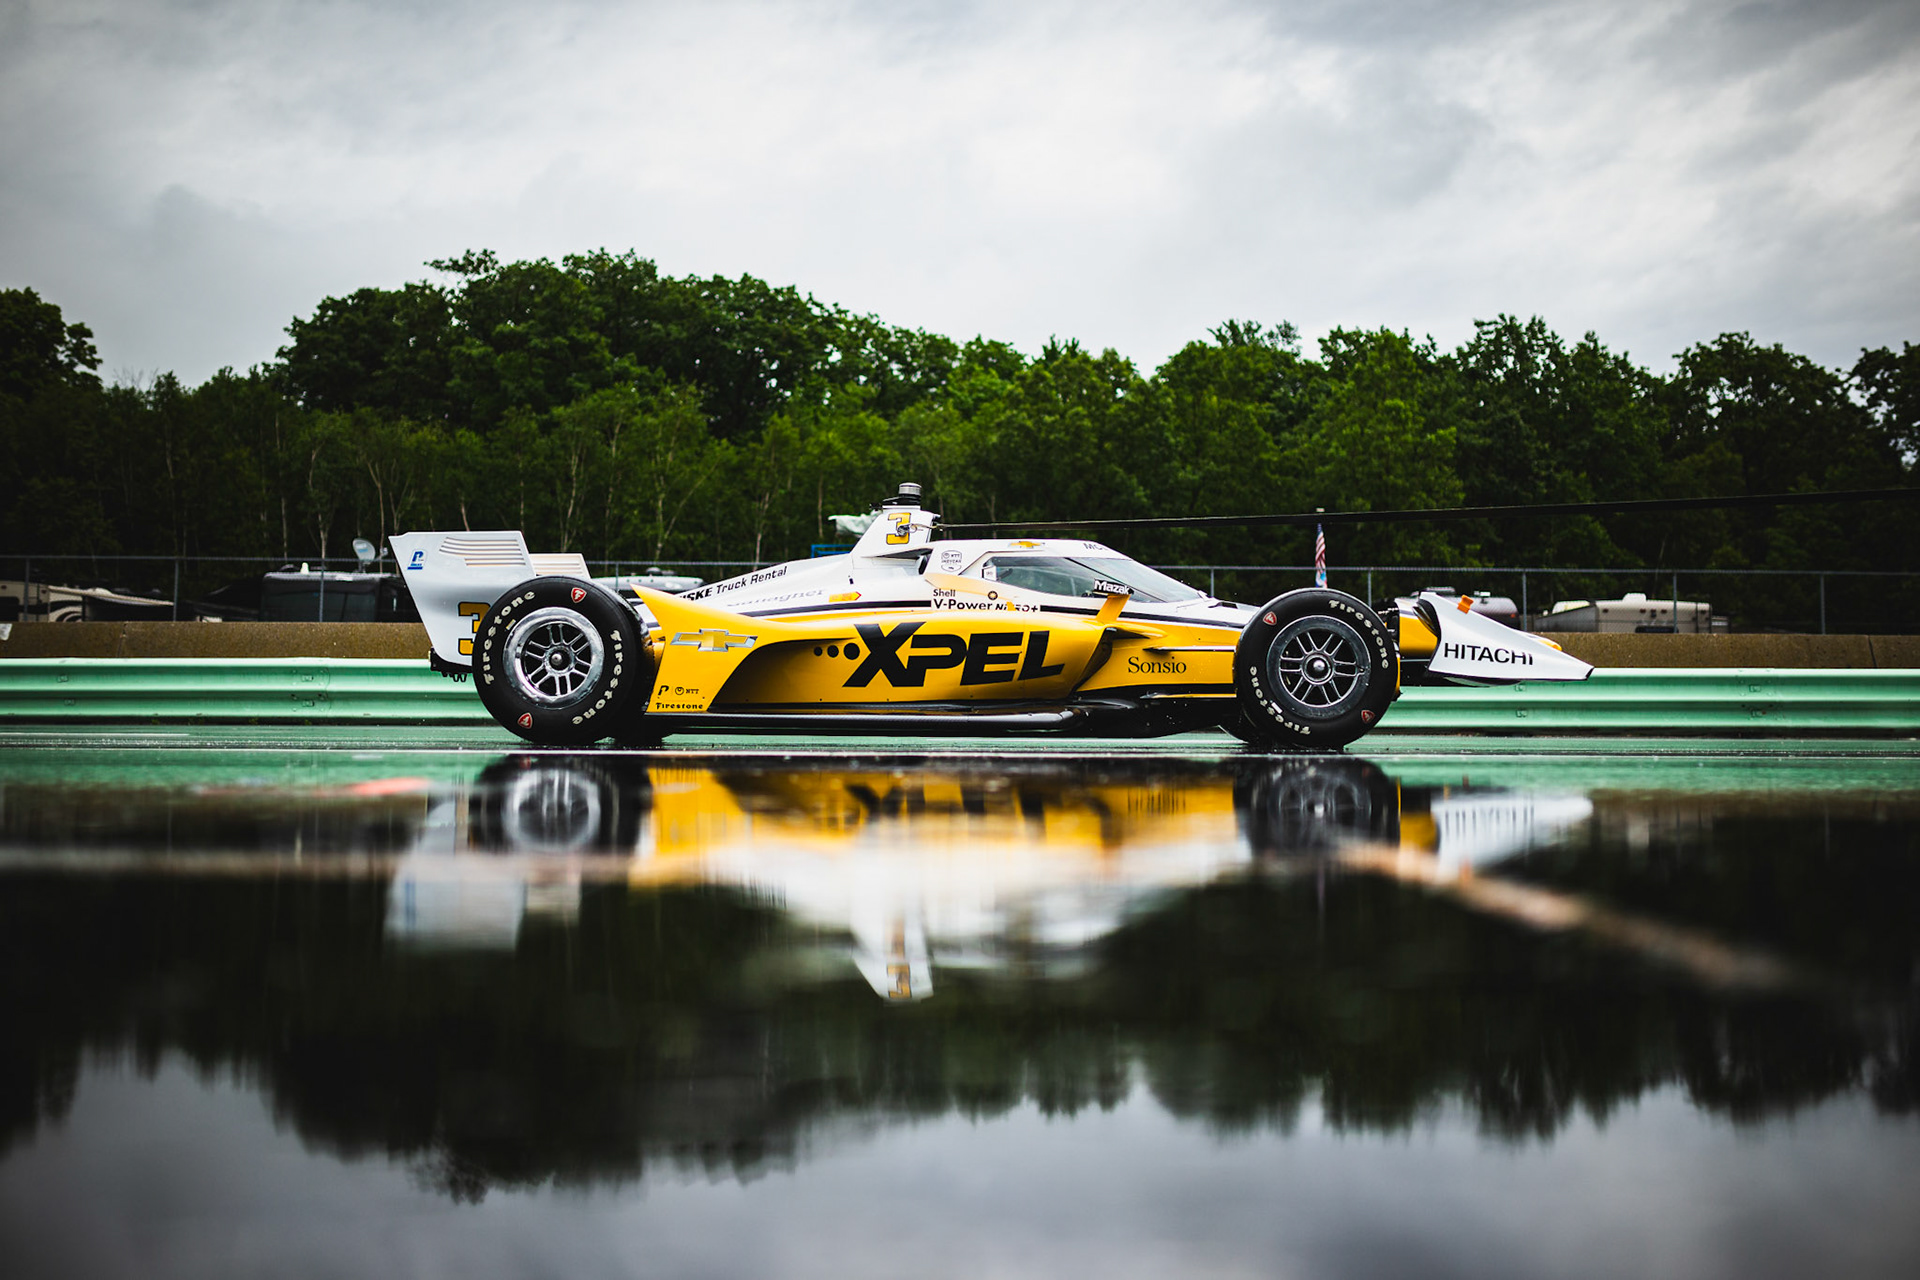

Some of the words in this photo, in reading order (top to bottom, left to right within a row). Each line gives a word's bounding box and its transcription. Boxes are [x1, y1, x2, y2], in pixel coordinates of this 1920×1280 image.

[886, 512, 912, 545] 3
[716, 577, 747, 595] Truck
[750, 565, 788, 585] Rental
[933, 588, 956, 598] Shell
[1094, 580, 1130, 595] Mazak
[934, 598, 993, 611] V-Power
[482, 591, 536, 685] Firestone
[1328, 600, 1390, 669] Firestone
[842, 621, 1066, 688] XPEL
[1128, 656, 1188, 674] Sonsio
[1444, 642, 1534, 666] HITACHI
[571, 630, 623, 725] Firestone
[656, 702, 704, 710] Firestone
[1249, 666, 1312, 735] Firestone
